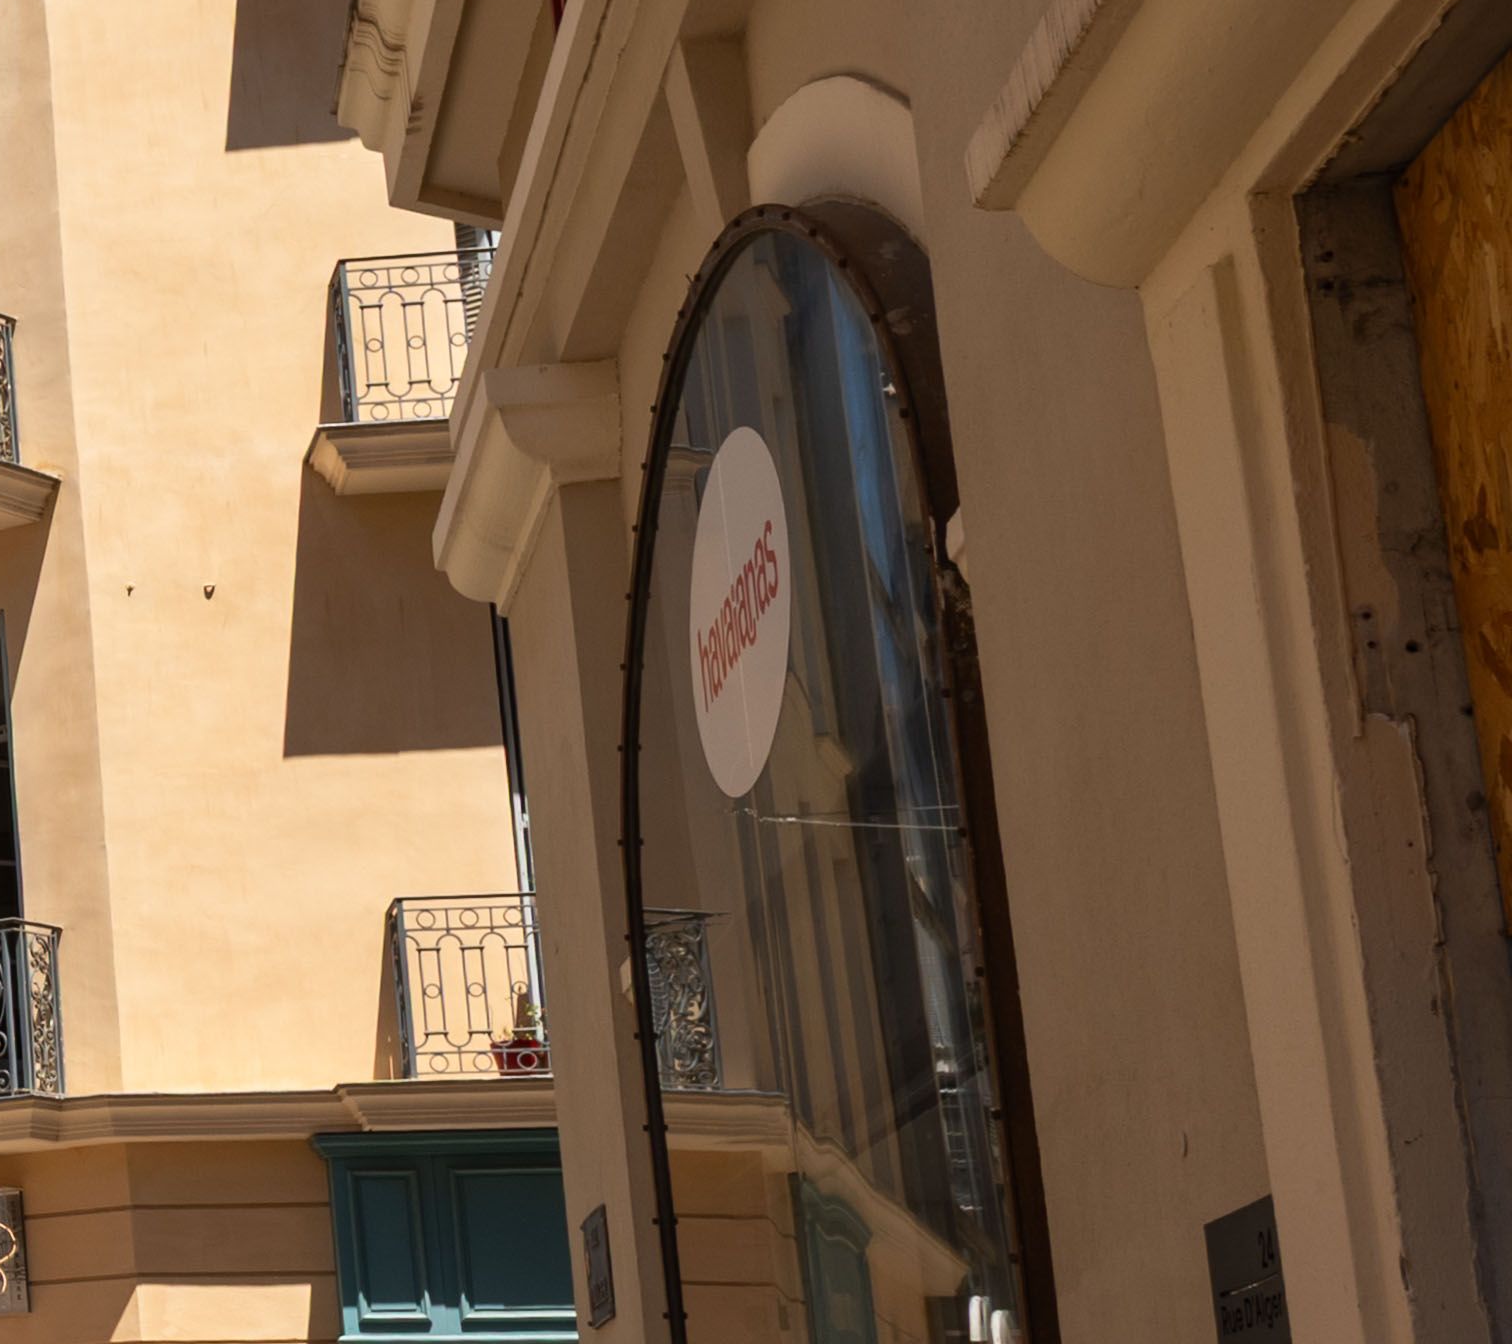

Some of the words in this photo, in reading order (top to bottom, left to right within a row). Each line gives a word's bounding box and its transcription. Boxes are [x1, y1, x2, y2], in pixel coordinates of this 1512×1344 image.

[697, 520, 779, 712] havaianas
[1257, 1227, 1275, 1269] 24
[1221, 1305, 1244, 1337] Rue
